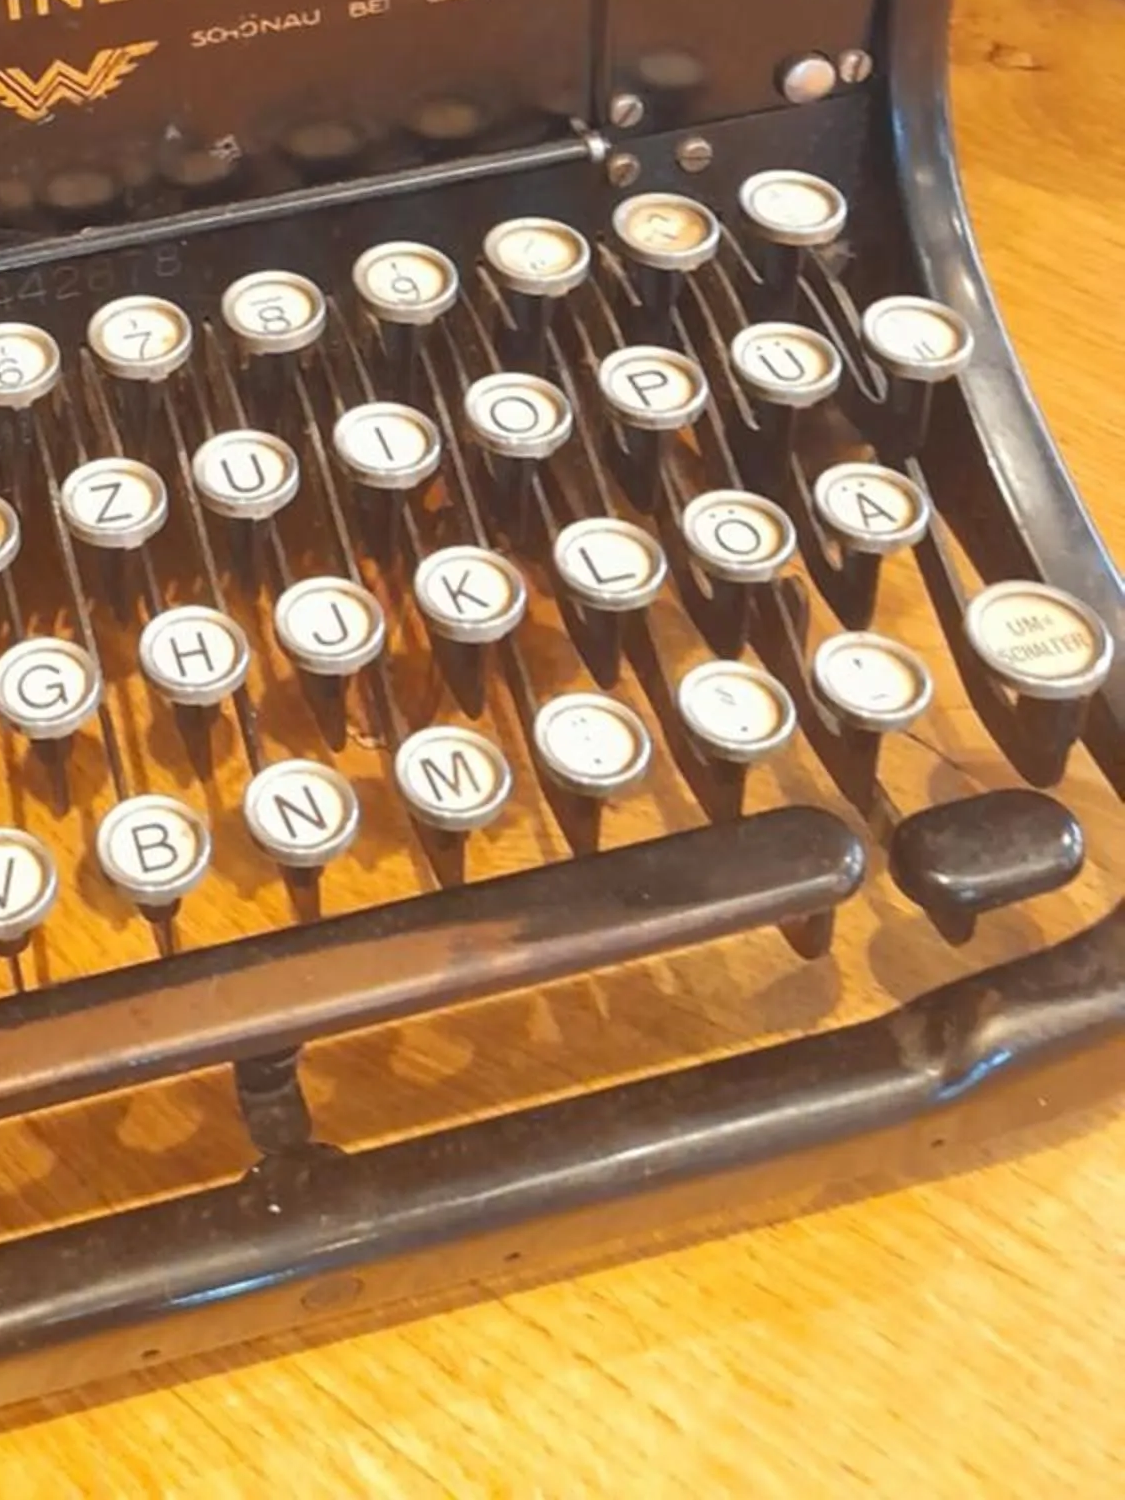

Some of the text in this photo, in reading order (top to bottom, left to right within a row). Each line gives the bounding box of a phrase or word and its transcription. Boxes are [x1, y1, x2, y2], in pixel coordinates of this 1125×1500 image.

[391, 275, 422, 305] 9
[257, 306, 292, 336] 8
[123, 330, 153, 360] 7
[756, 341, 805, 382] Ü
[627, 369, 669, 407] P
[490, 396, 539, 433] O
[375, 426, 394, 461] I
[220, 453, 264, 492] U
[90, 481, 133, 524] Z
[842, 482, 897, 528] Ä
[709, 509, 761, 555] Ö
[579, 546, 636, 584] L
[441, 570, 490, 614] K
[312, 601, 350, 647] J
[169, 631, 214, 678] H
[16, 663, 68, 709] G
[420, 750, 482, 802] M
[274, 785, 329, 839] N
[131, 822, 178, 873] B
